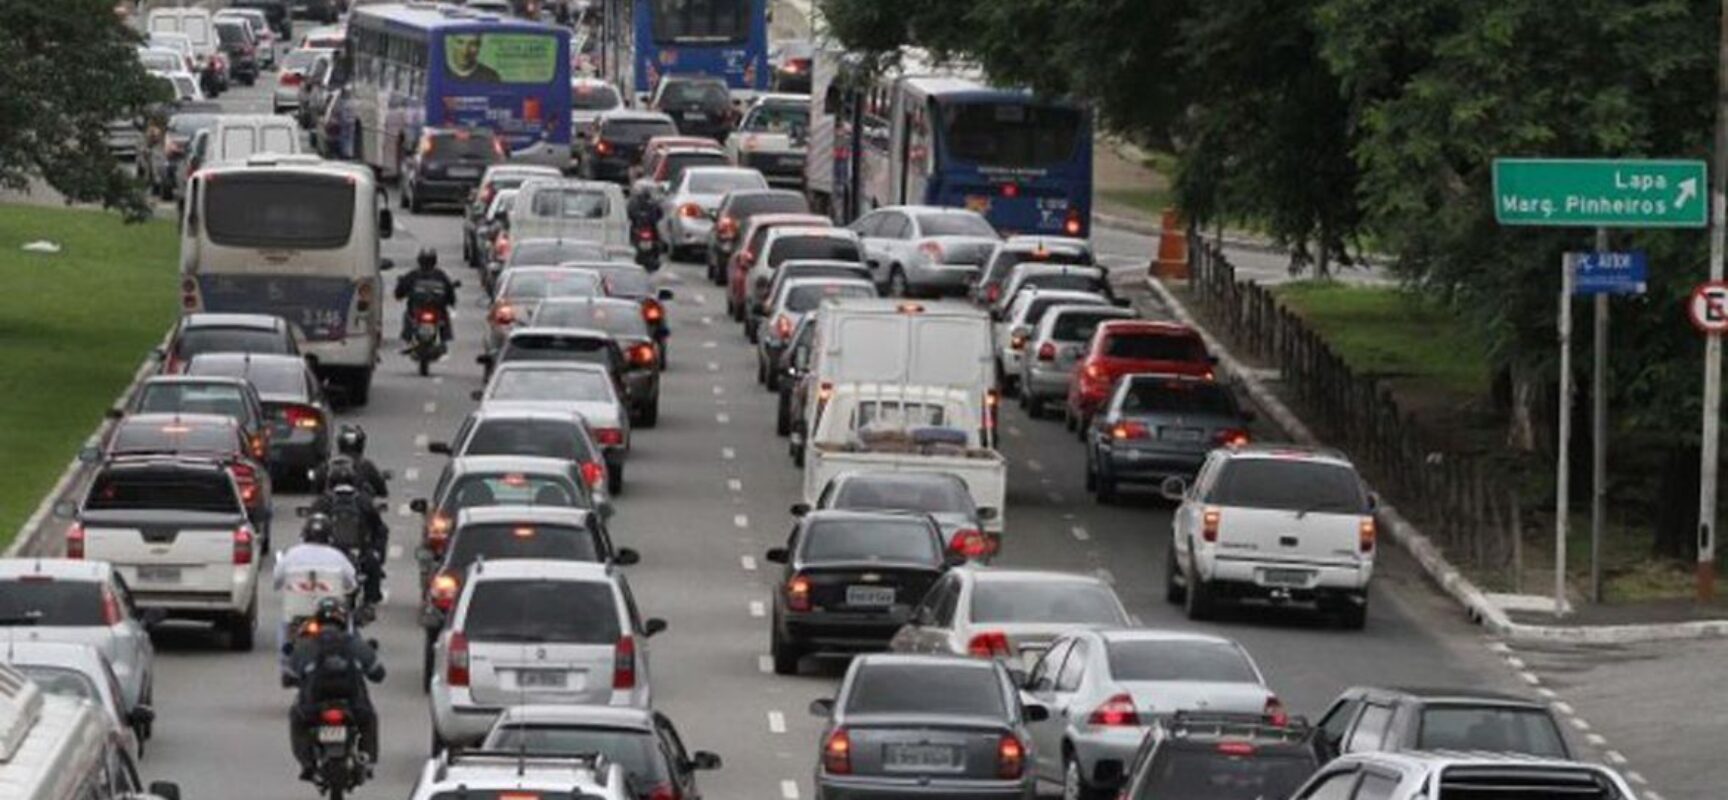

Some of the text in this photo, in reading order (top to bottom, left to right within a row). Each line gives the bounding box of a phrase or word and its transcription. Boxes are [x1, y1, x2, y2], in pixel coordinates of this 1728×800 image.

[1615, 171, 1667, 192] Lapa
[1566, 195, 1666, 215] Pinheiros
[1706, 292, 1724, 321] E
